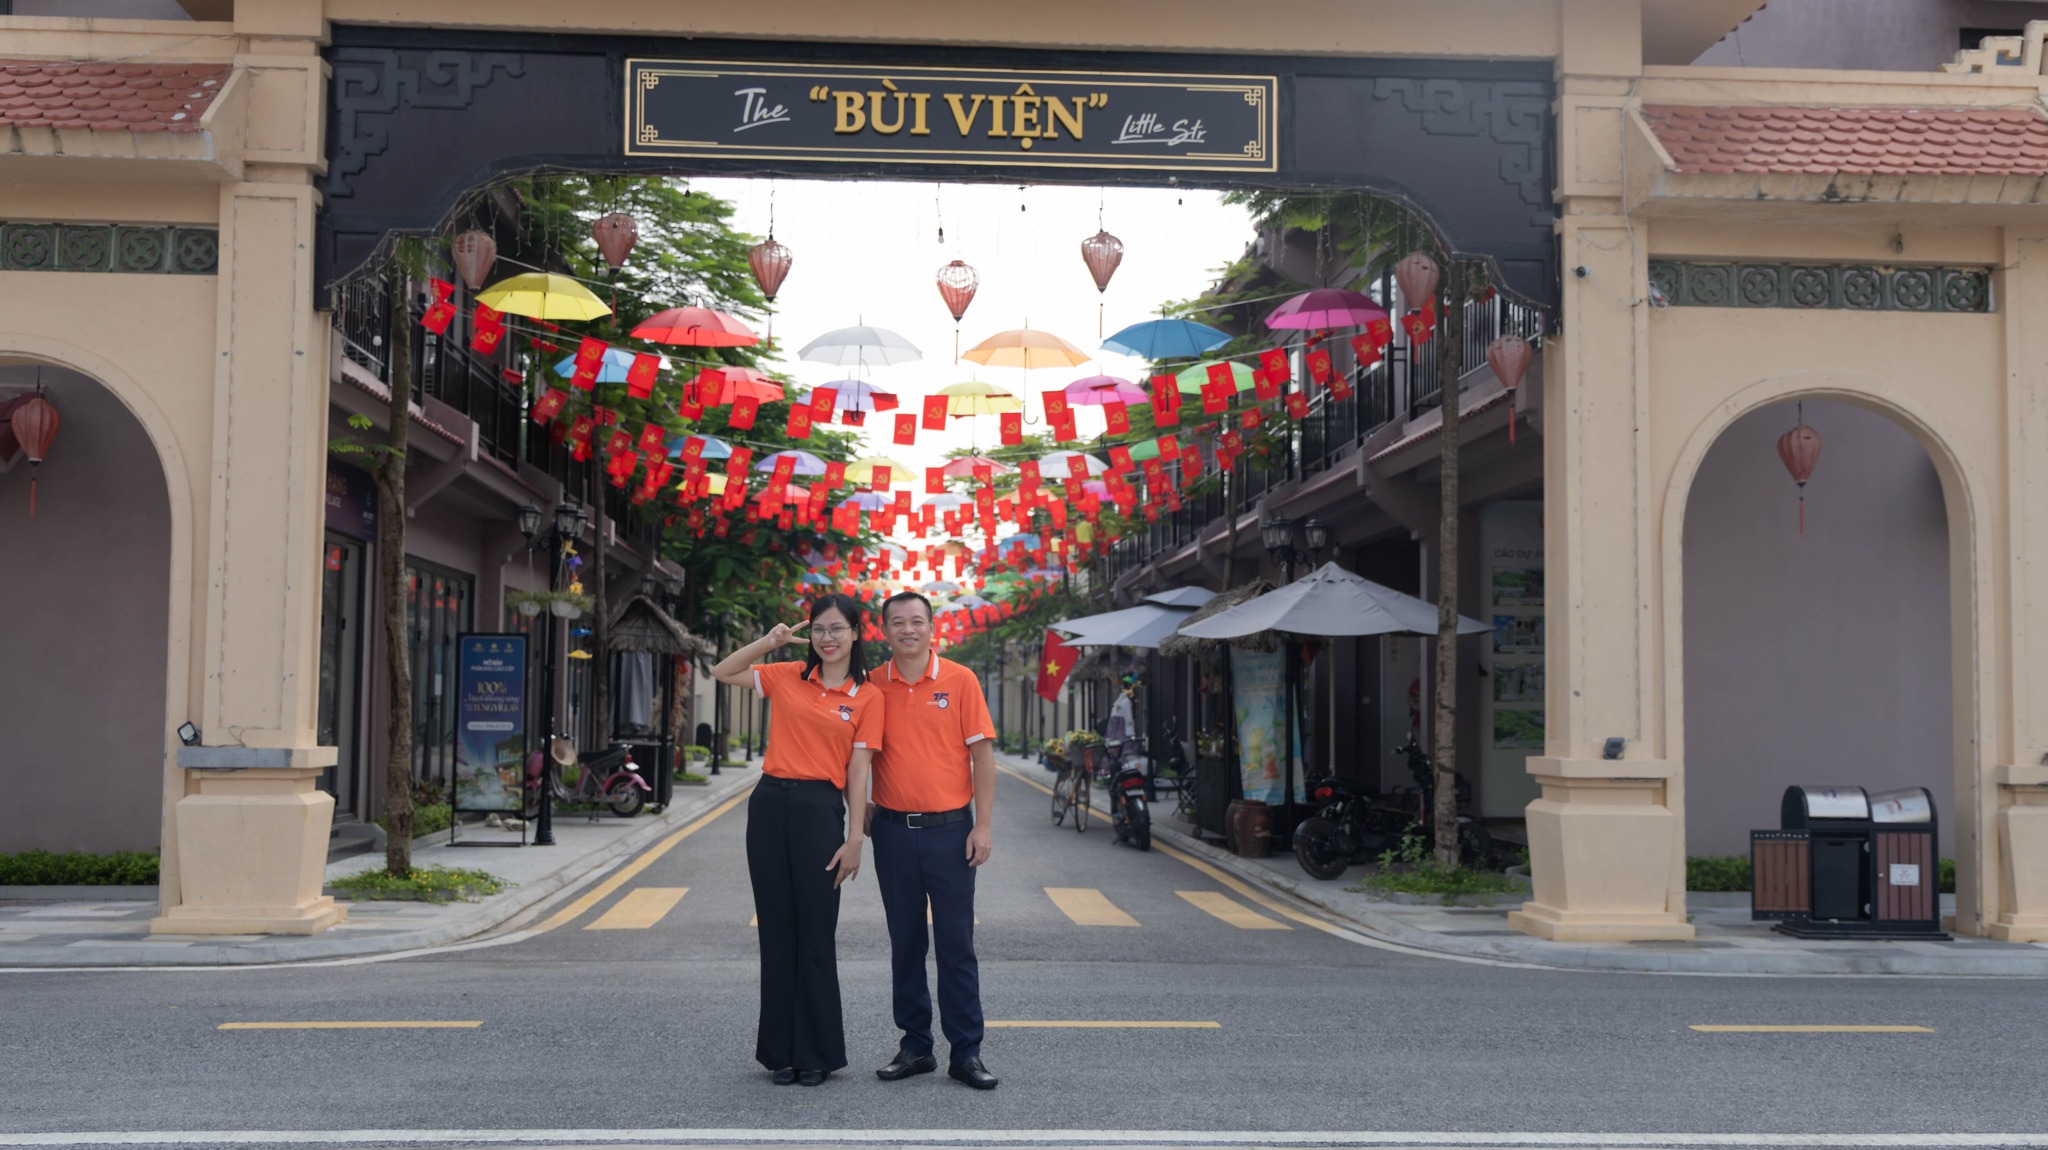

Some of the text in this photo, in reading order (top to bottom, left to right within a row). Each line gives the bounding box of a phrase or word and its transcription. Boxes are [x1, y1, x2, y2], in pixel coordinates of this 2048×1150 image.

[734, 79, 1207, 149] The “BÙI VIỆN” Little Str
[477, 681, 507, 694] 100%
